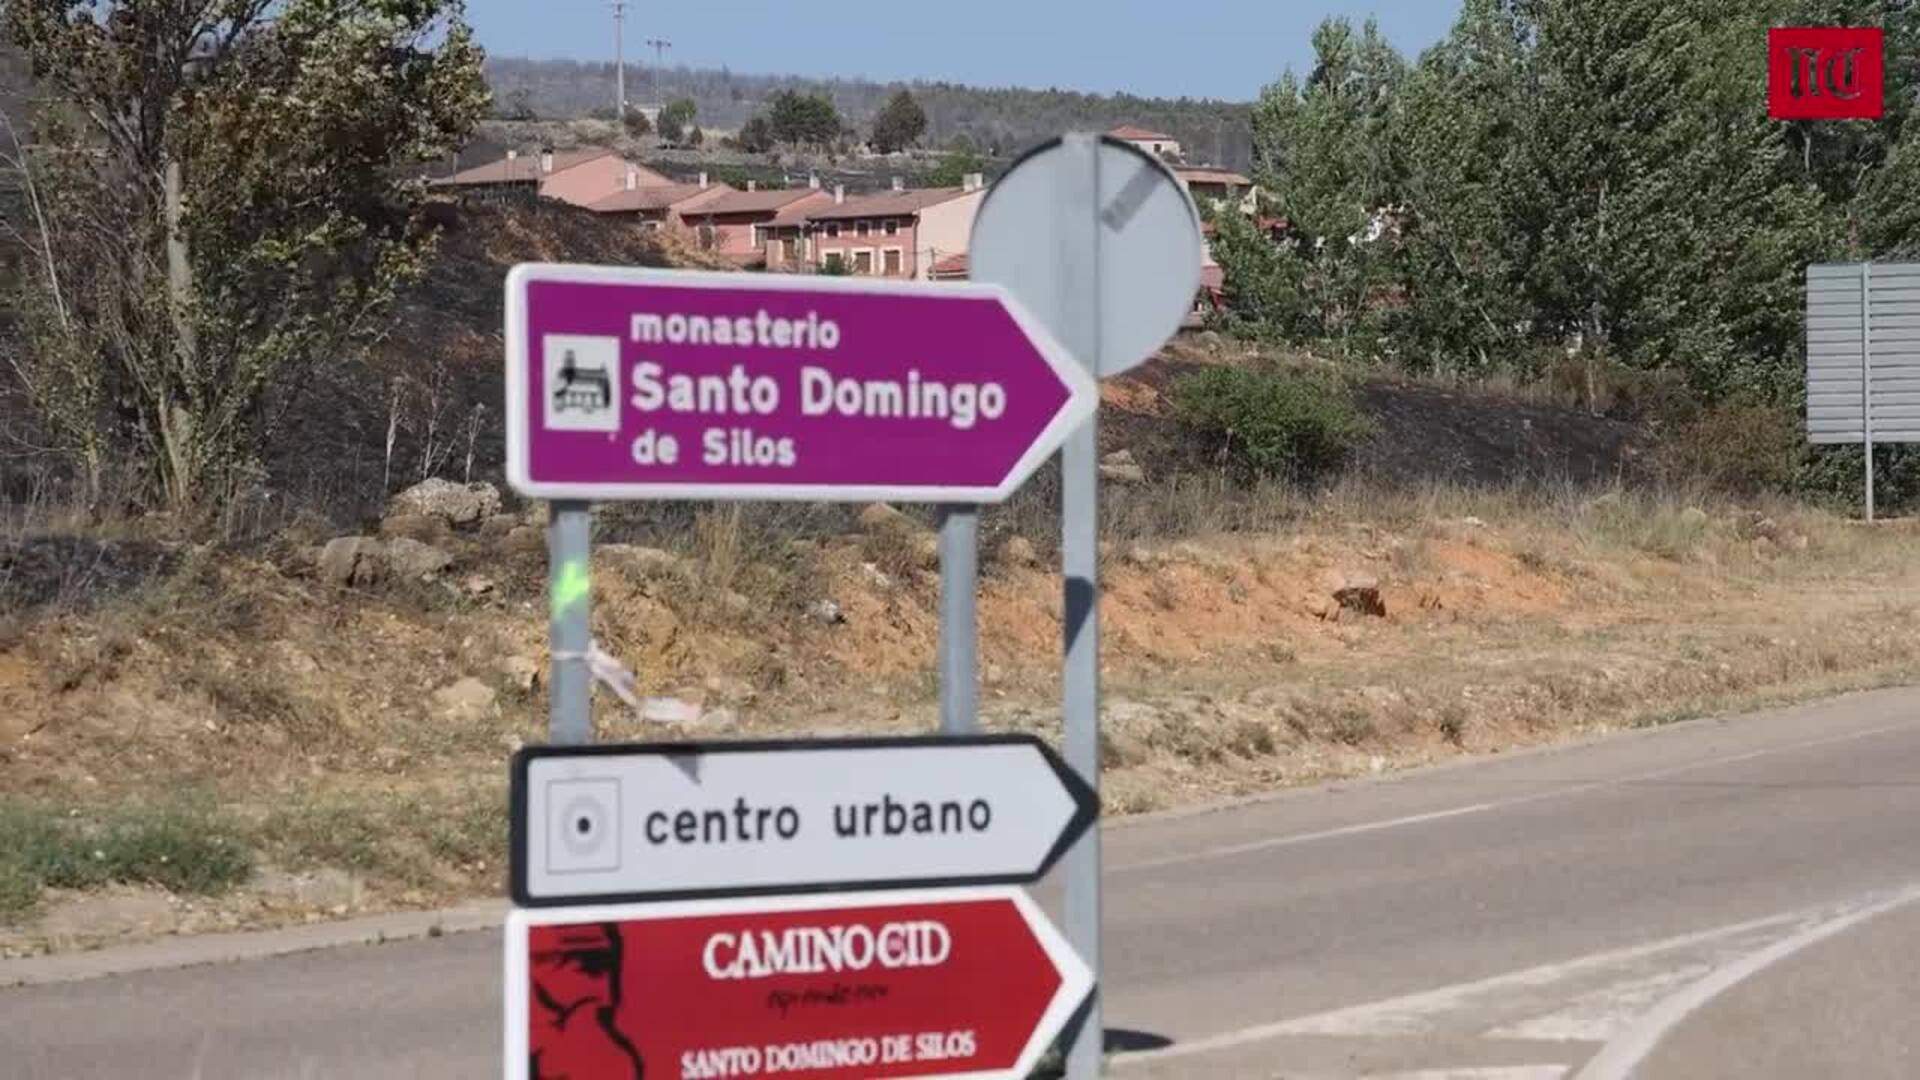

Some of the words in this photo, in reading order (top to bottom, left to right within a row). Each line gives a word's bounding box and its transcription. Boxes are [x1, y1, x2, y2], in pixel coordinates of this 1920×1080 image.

[630, 310, 840, 350] monasterio
[631, 362, 779, 415] Santo
[801, 367, 1006, 428] Domingo
[632, 430, 678, 464] de
[703, 429, 797, 467] Silos
[645, 797, 801, 845] centro
[834, 794, 991, 837] urbano
[680, 1047, 762, 1080] SANTO
[765, 1037, 879, 1073] DOMINGO
[880, 1033, 914, 1063] DE
[914, 1029, 978, 1060] SILOS
